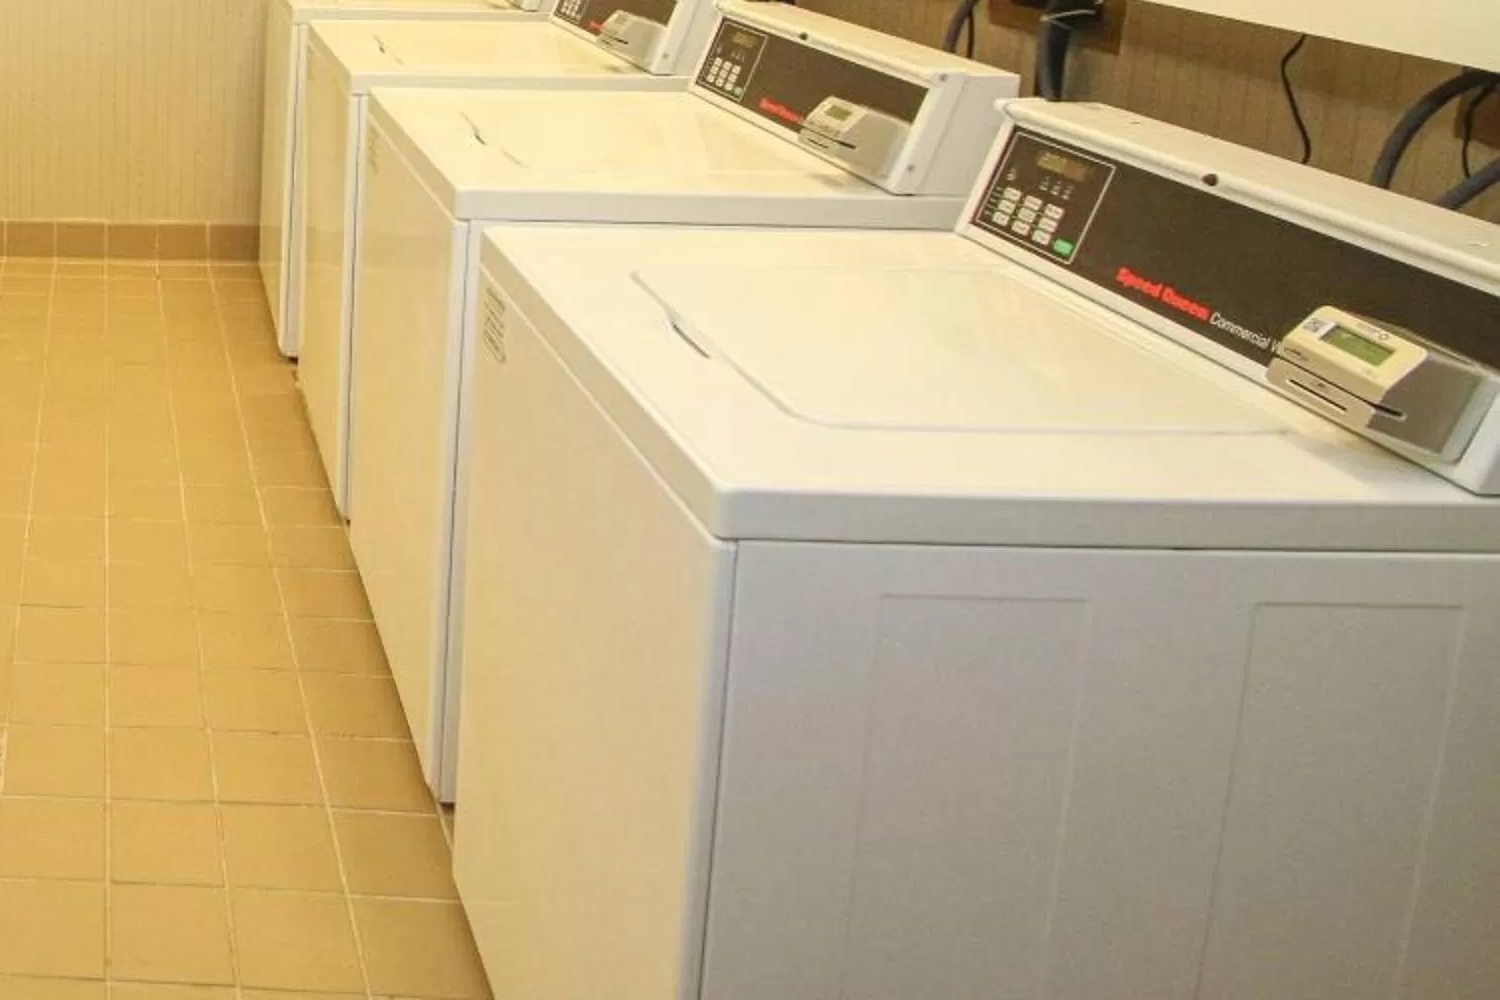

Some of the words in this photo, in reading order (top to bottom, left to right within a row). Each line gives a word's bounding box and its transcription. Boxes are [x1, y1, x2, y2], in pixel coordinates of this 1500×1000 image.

[1115, 266, 1164, 299] Speed
[1160, 285, 1211, 323] Queen
[1209, 311, 1272, 350] Commercial
